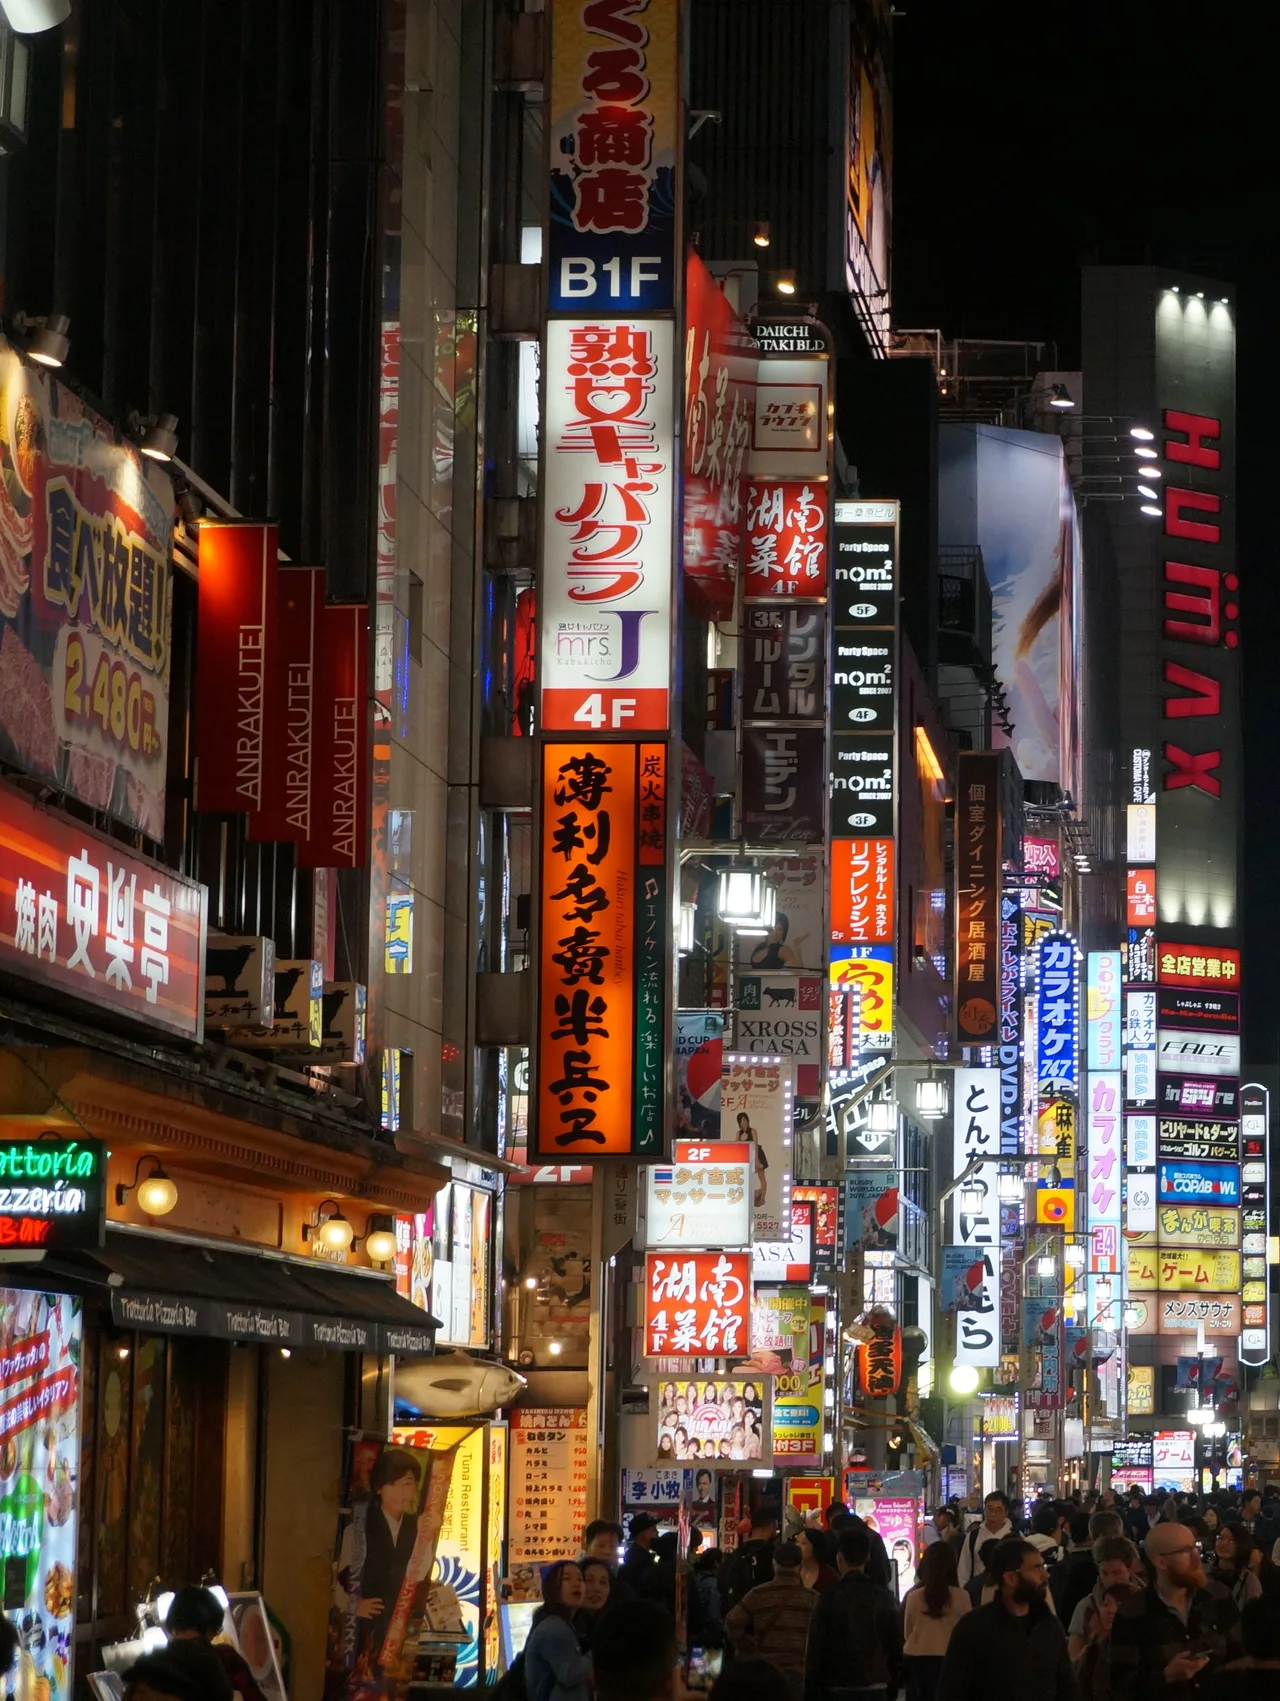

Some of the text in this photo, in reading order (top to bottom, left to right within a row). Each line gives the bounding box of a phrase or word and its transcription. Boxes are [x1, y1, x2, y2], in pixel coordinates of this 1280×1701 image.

[560, 256, 662, 297] B1F
[756, 325, 809, 337] DAIICHI
[555, 325, 666, 605] 熟女キャバクラ
[746, 486, 826, 534] 湖南
[746, 536, 826, 578] 菜館
[838, 542, 889, 552] Party Space
[770, 579, 800, 594] 4F
[856, 606, 871, 616] 5F
[583, 610, 659, 682] J
[838, 646, 889, 656] Party Space
[557, 656, 612, 667] Kabukicho
[788, 610, 818, 715] レンタル
[752, 638, 782, 714] ルーム
[235, 622, 265, 802] ANRAKUTEI
[573, 693, 637, 729] 4F
[855, 711, 870, 721] 4F
[285, 662, 313, 832] ANRAKUTEI
[838, 750, 889, 761] Party Space
[331, 696, 358, 858] ANRAKUTEI
[764, 732, 799, 811] エデン
[638, 752, 665, 850] 炭火串焼
[854, 815, 870, 825] 3F
[850, 842, 870, 941] リフレッシュ
[875, 841, 888, 937] レンタルルーム ホステル
[967, 783, 986, 983] 個室ダイニング居酒屋
[14, 877, 59, 964] 焼肉
[831, 931, 845, 940] 2F
[850, 946, 873, 959] 1F
[1161, 954, 1237, 980] 全店営業中
[744, 982, 758, 997] 肉
[1042, 940, 1072, 1057] カラオケ
[739, 1019, 819, 1038] XROSS
[1143, 993, 1156, 1042] カラオケ
[749, 1038, 812, 1056] CASA
[1161, 1041, 1237, 1058] FACE
[1039, 1058, 1072, 1077] 747
[1134, 1053, 1149, 1096] SEGA
[1135, 1099, 1147, 1107] 2F
[1091, 1079, 1117, 1215] カラオケ
[1134, 1119, 1149, 1163] SEGA
[687, 1148, 711, 1161] 2F
[676, 1166, 745, 1185] タイ古式
[653, 1188, 744, 1206] マッサージ
[1161, 1208, 1236, 1235] まんが喫茶
[651, 1255, 745, 1304] 湖南
[1161, 1262, 1210, 1284] ゲーム
[1164, 1301, 1233, 1317] メンズサウナ
[673, 1309, 744, 1354] 菜館
[526, 1447, 549, 1455] カルビ
[1156, 1447, 1193, 1462] ゲーム
[525, 1472, 548, 1480] ロース
[459, 1452, 473, 1553] Tuna Restaurant
[650, 1480, 681, 1501] 小牧
